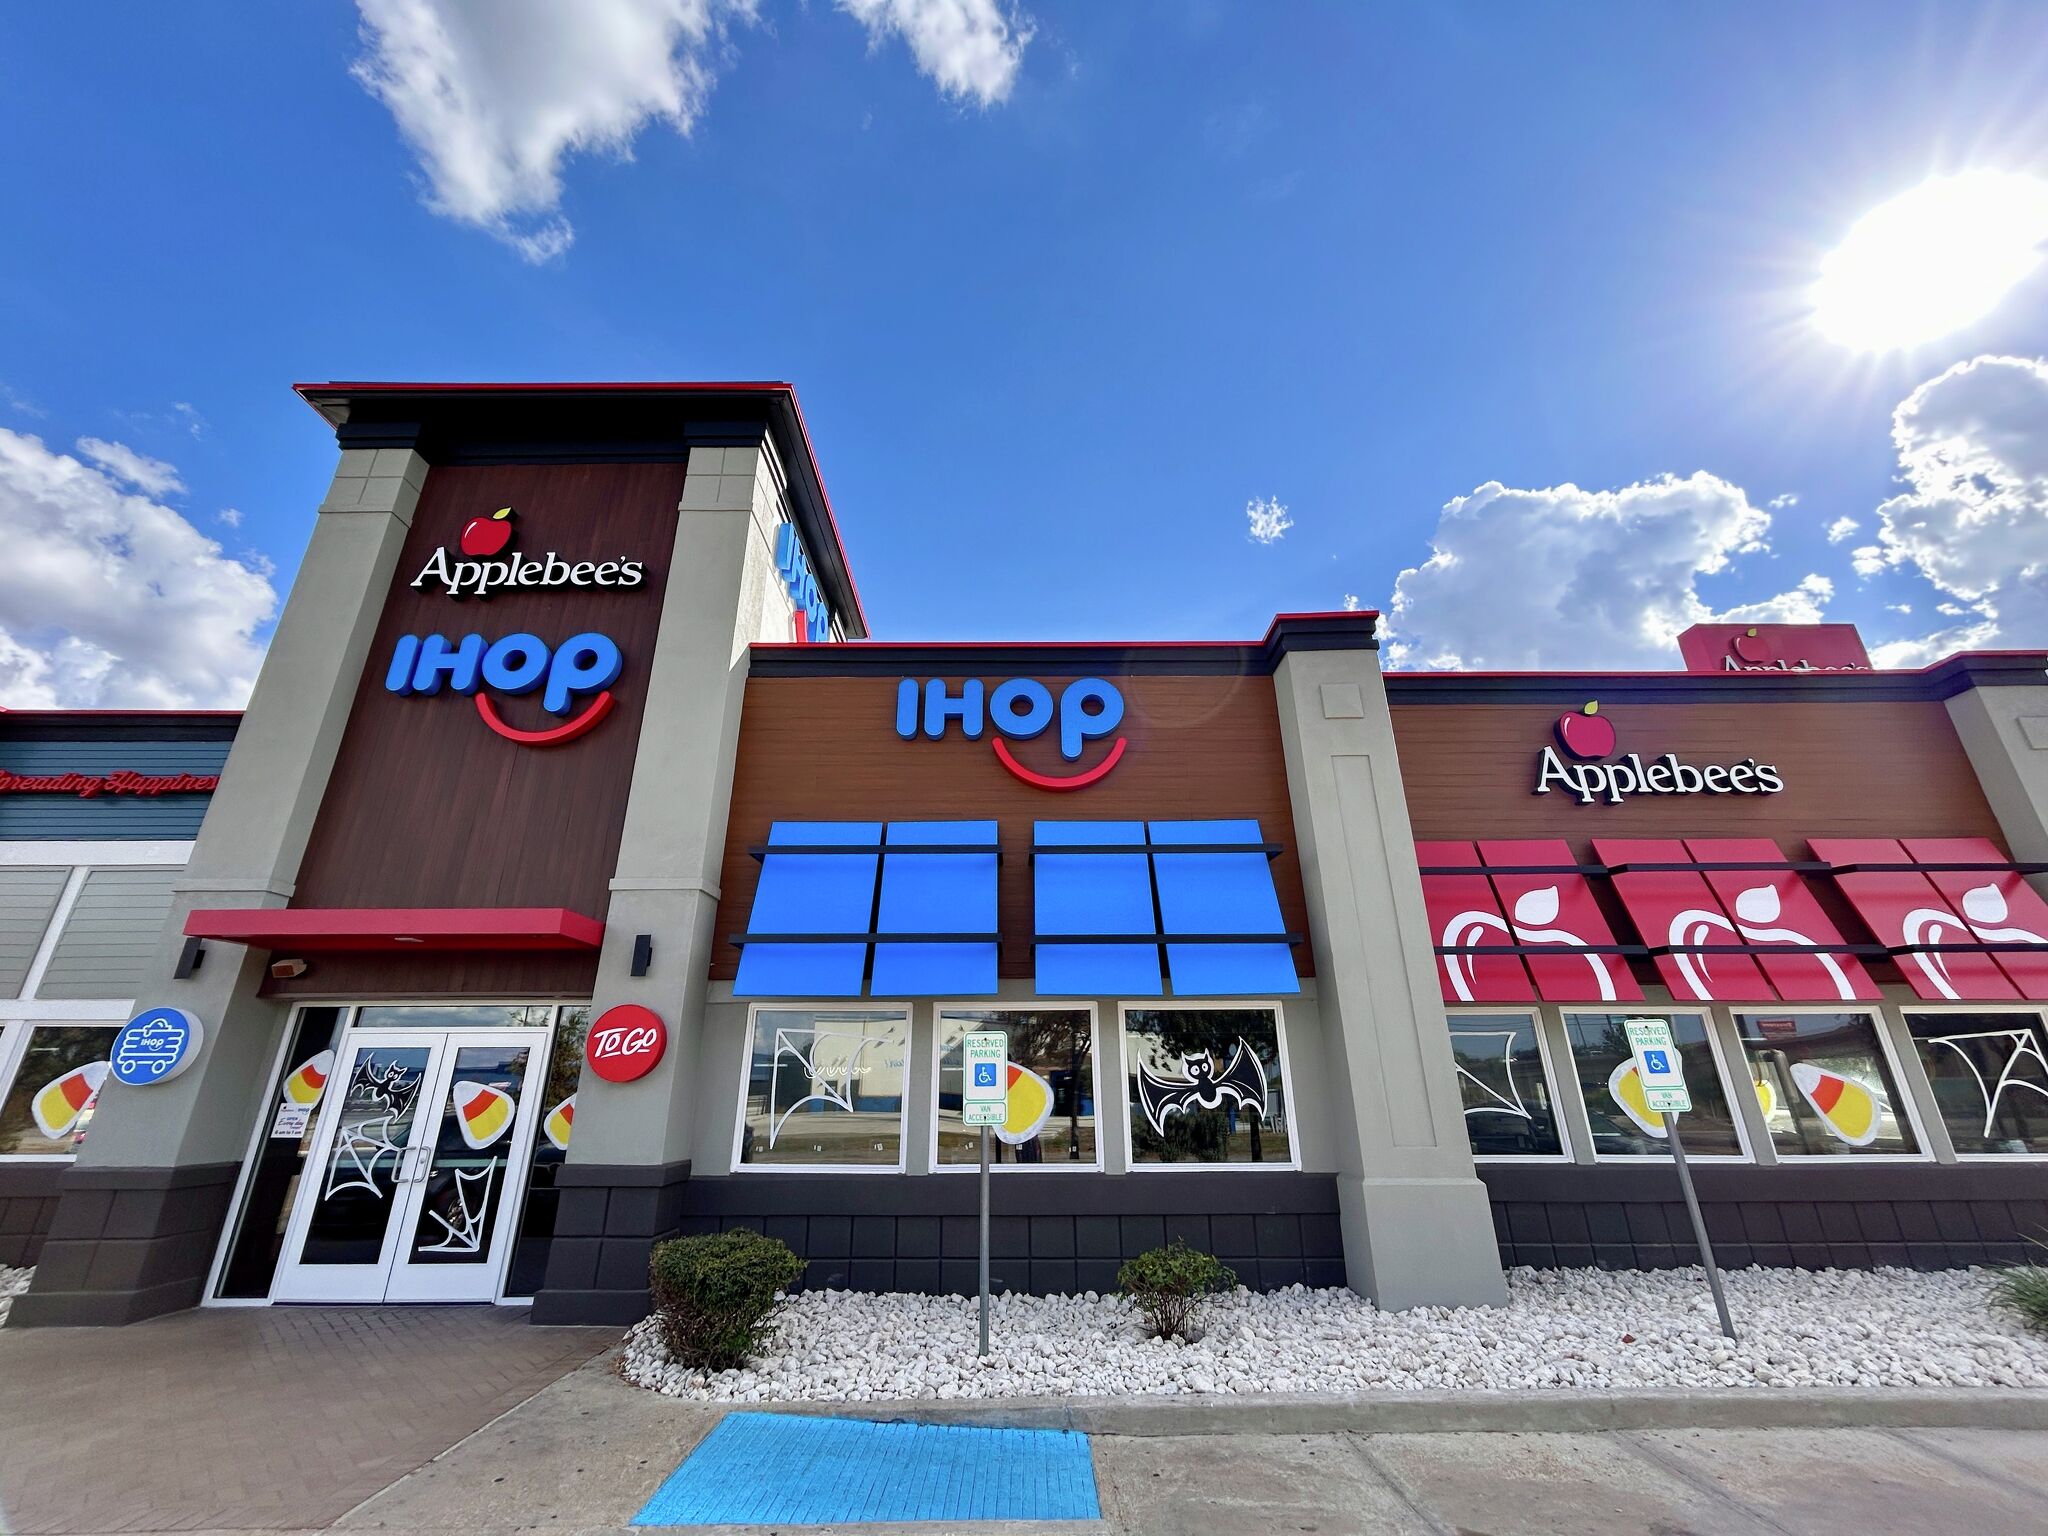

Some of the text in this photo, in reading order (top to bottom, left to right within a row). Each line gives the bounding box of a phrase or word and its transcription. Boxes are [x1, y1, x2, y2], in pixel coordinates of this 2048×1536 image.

[410, 546, 643, 594] Applebee's
[385, 632, 624, 716] IHOP
[896, 677, 1126, 762] IHOP
[1536, 745, 1785, 804] Applebee's
[1628, 1026, 1667, 1036] RESERVED
[140, 1038, 165, 1048] IHOP
[967, 1039, 1004, 1048] RESERVED
[1635, 1036, 1667, 1046] PARKING
[970, 1049, 1001, 1058] PARKING
[979, 1104, 992, 1112] VAN
